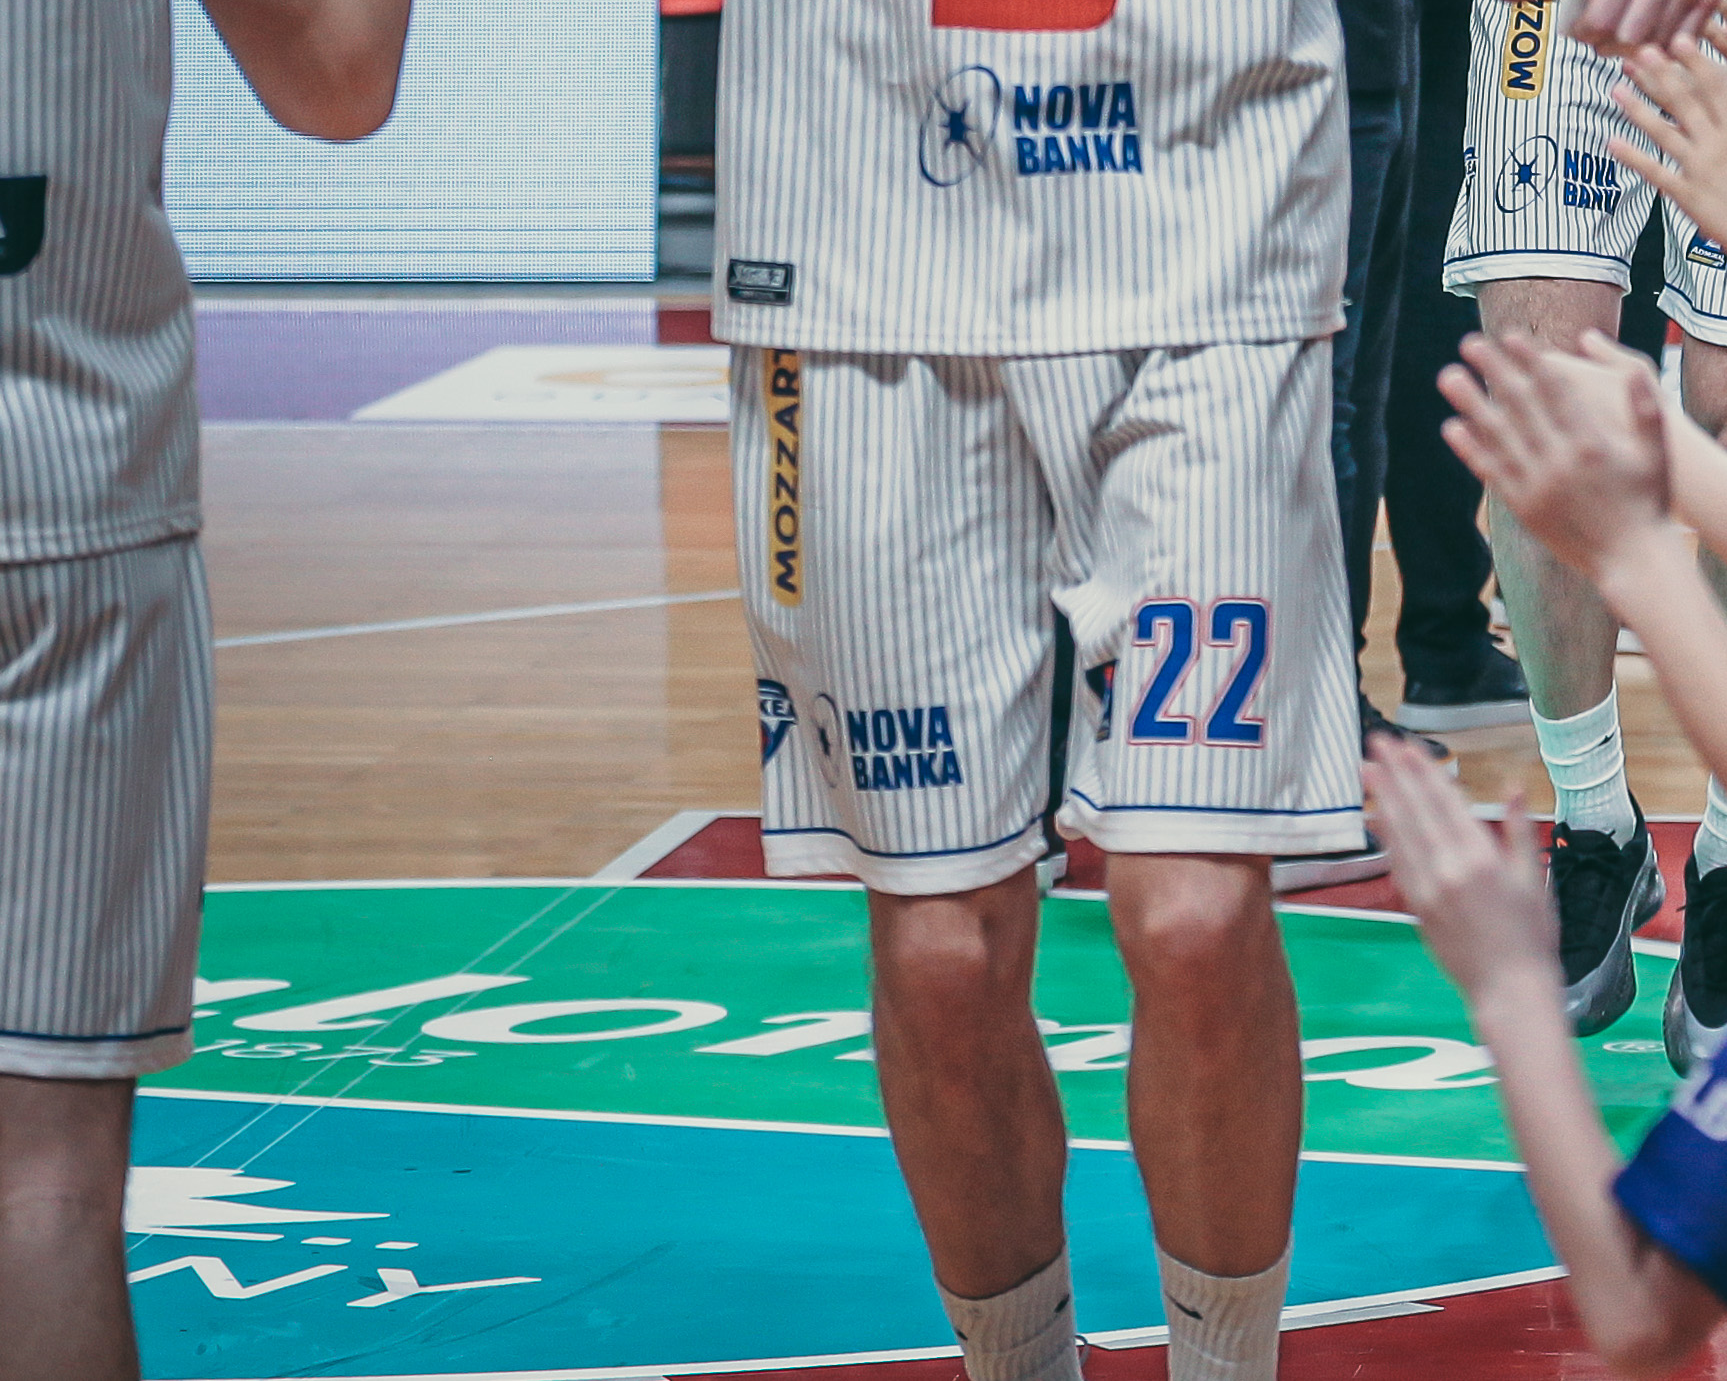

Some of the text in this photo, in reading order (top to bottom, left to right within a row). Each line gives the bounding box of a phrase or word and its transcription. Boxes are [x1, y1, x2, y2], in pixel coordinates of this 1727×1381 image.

[1013, 82, 1137, 130] NOVA
[1016, 134, 1143, 175] BANKA
[1563, 149, 1617, 188] NOVA
[1128, 597, 1270, 749] 22
[847, 706, 952, 752] NOVA
[852, 751, 962, 790] BANKA
